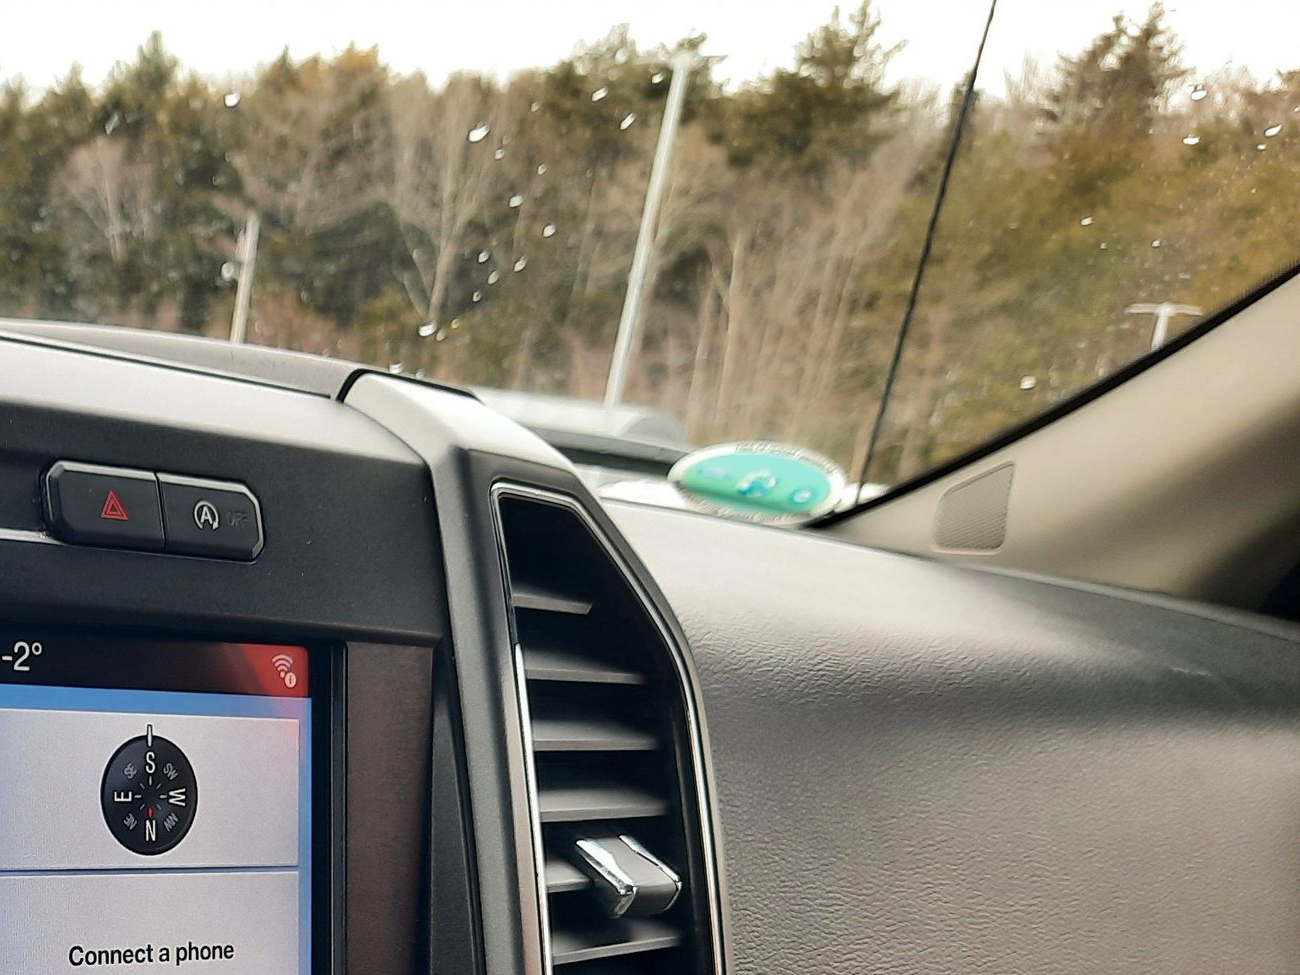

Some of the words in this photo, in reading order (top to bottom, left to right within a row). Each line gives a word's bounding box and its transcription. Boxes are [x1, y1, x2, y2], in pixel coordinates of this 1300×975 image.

[145, 751, 156, 774] S
[163, 762, 179, 780] SW
[113, 791, 132, 802] E
[168, 788, 186, 807] W
[145, 819, 156, 841] N
[68, 943, 154, 968] Connect
[158, 945, 171, 963] a
[175, 941, 235, 968] phone
